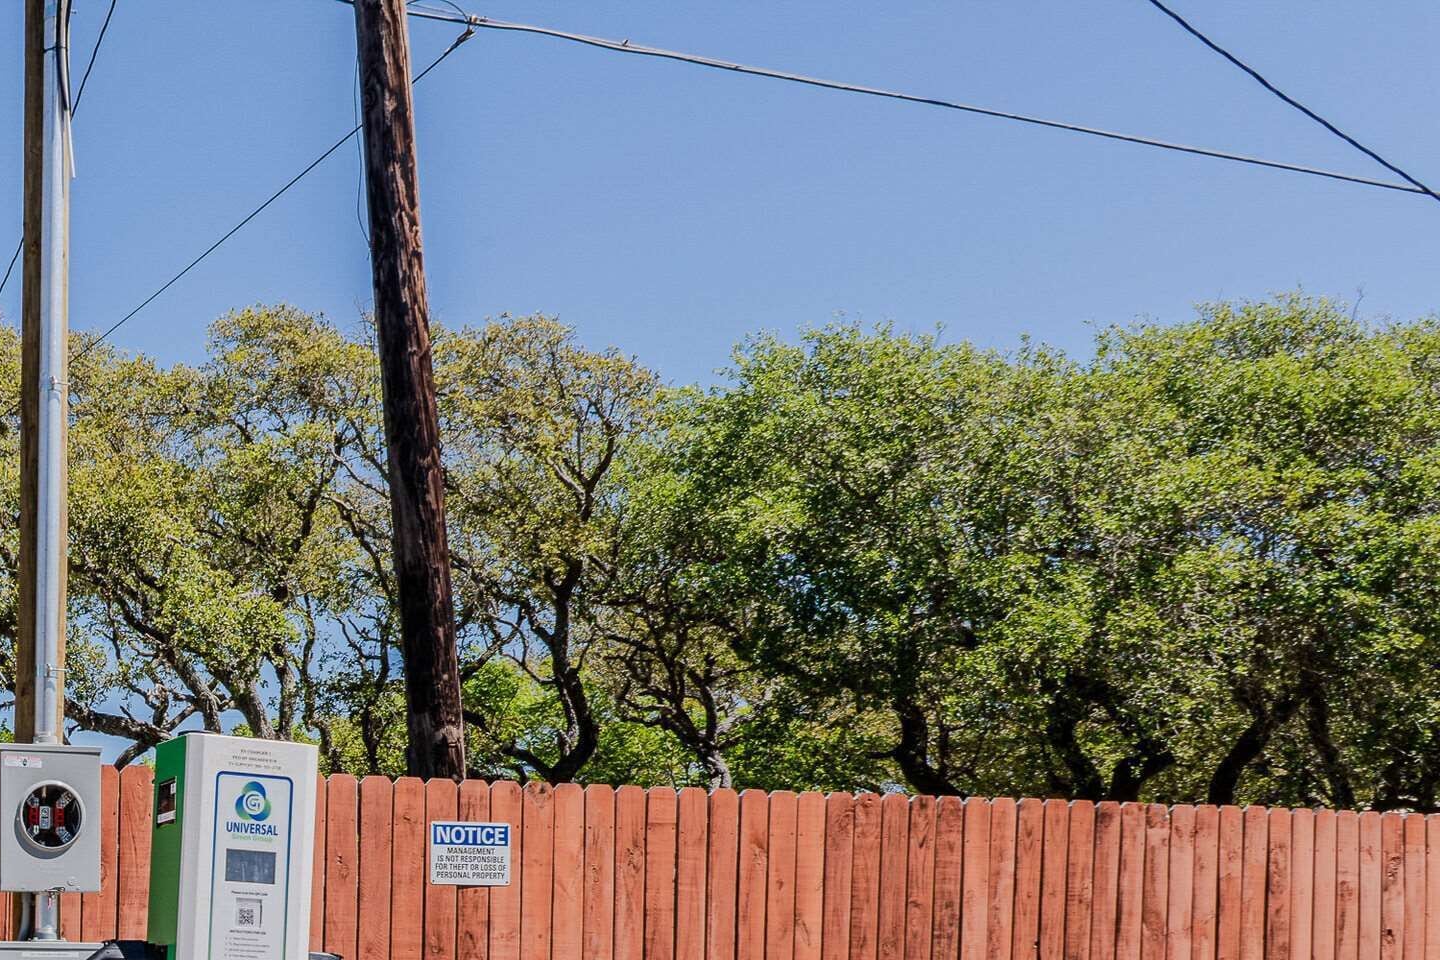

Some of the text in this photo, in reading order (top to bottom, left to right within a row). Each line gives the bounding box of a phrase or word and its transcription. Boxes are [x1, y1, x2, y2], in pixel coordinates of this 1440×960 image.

[226, 821, 279, 836] UNIVERSAL
[436, 826, 506, 845] NOTICE
[447, 847, 495, 855] MANAGEMENT
[445, 855, 459, 863] NOT
[460, 856, 504, 864] RESPONSIBLE
[435, 863, 447, 871] FOR
[449, 863, 469, 871] THEFT
[480, 864, 497, 872] LOSS
[436, 871, 505, 880] PERSONAL PROPERTY
